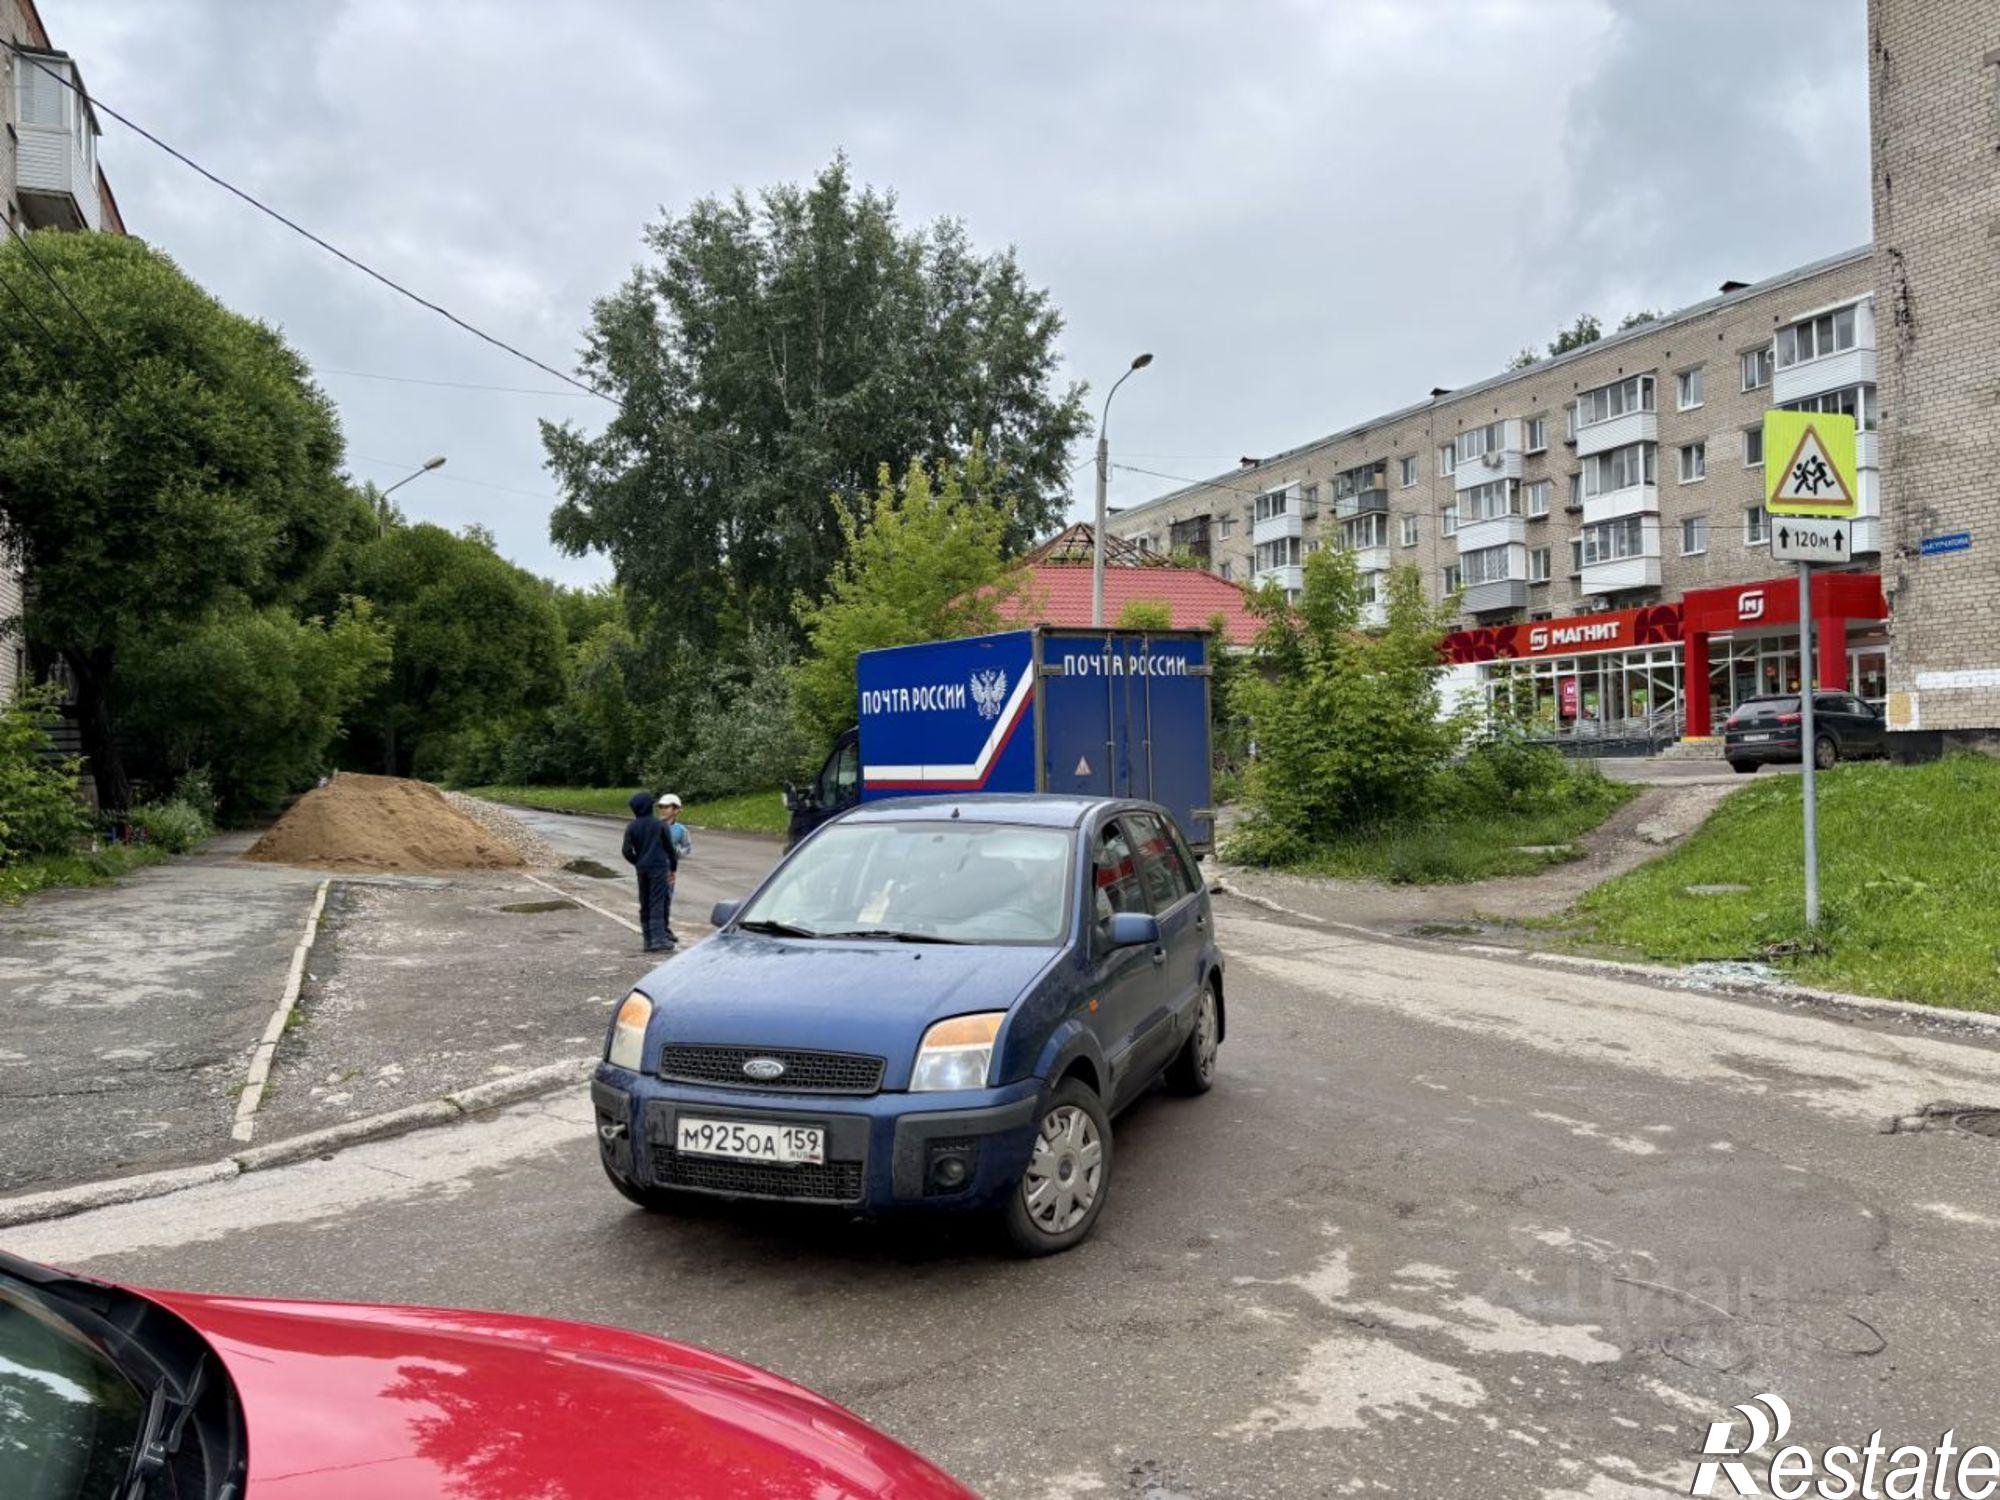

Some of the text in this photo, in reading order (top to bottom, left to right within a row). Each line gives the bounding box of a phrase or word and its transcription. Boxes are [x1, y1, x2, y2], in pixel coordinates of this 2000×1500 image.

[1794, 530, 1829, 548] 120м
[1551, 621, 1621, 645] МАГНИТ
[1063, 654, 1187, 677] ПОЧТА РОССИИ
[861, 683, 966, 715] ПОЧТА РОССИИ
[782, 1129, 818, 1151] 159
